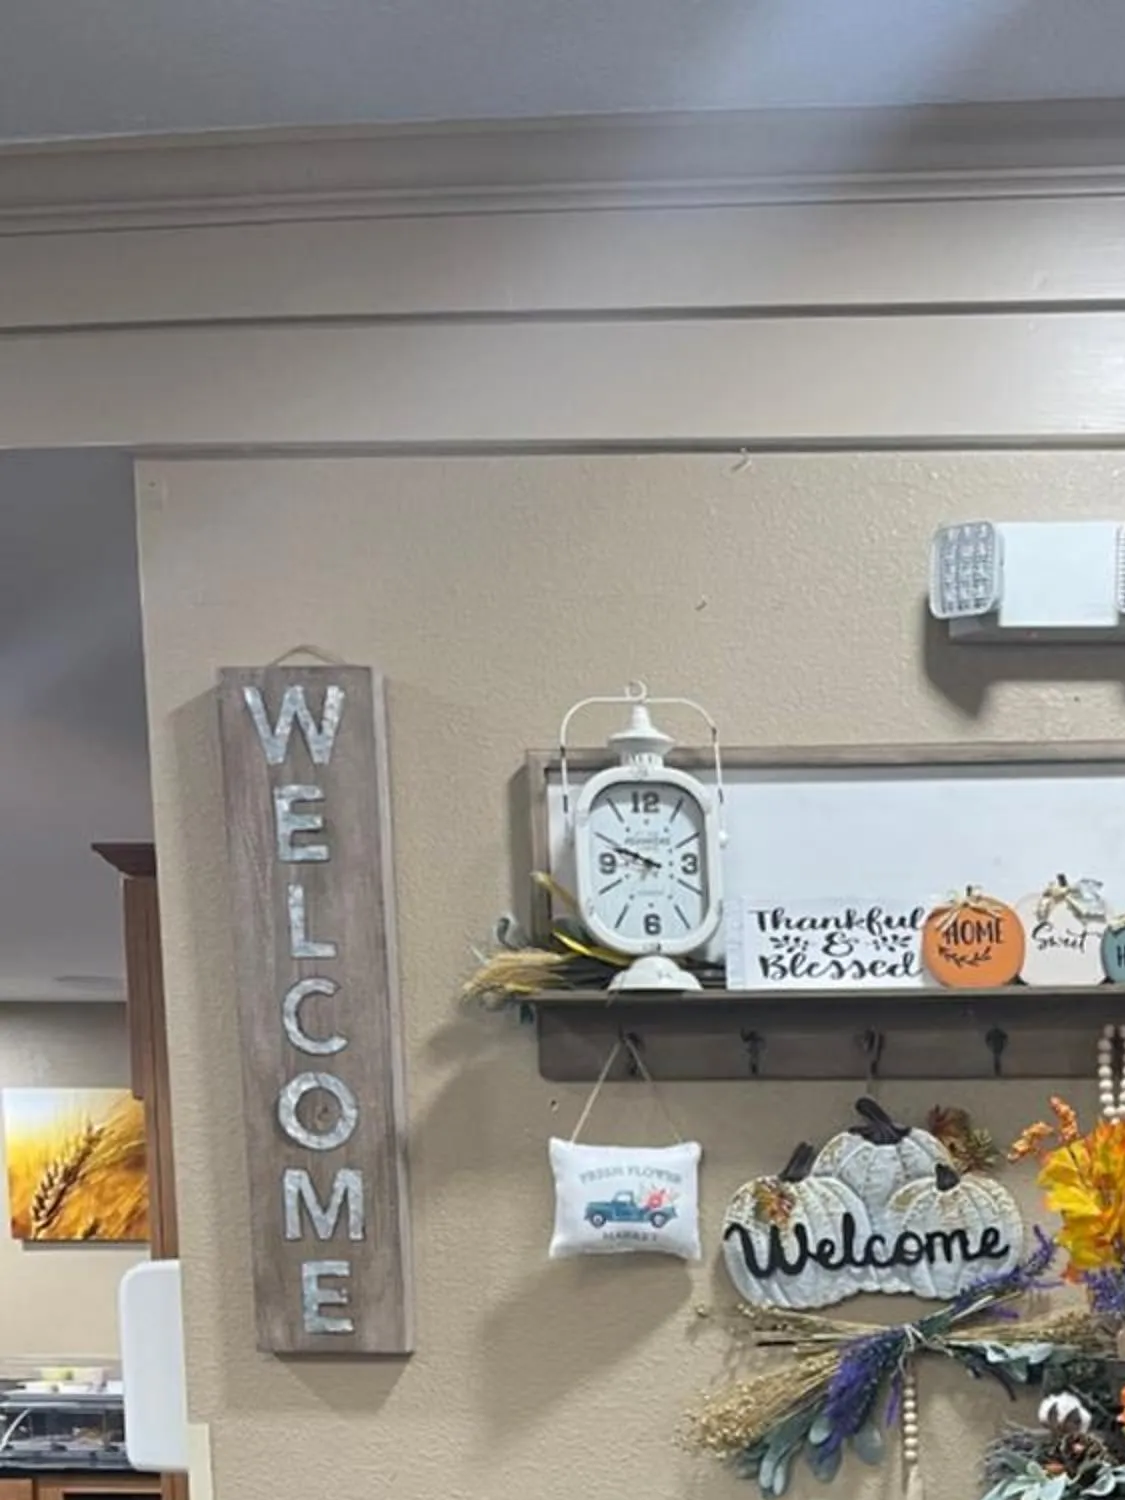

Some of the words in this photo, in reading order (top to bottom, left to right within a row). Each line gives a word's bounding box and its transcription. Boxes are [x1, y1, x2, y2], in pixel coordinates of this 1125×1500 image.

[630, 790, 660, 814] 12
[598, 852, 617, 875] 9
[680, 852, 698, 875] 3
[643, 912, 663, 936] 6
[749, 906, 925, 936] Thankful
[943, 917, 1004, 945] HOME
[758, 952, 924, 981] Blessed
[243, 685, 364, 1335] WELCOME
[724, 1212, 1010, 1278] Welcome
